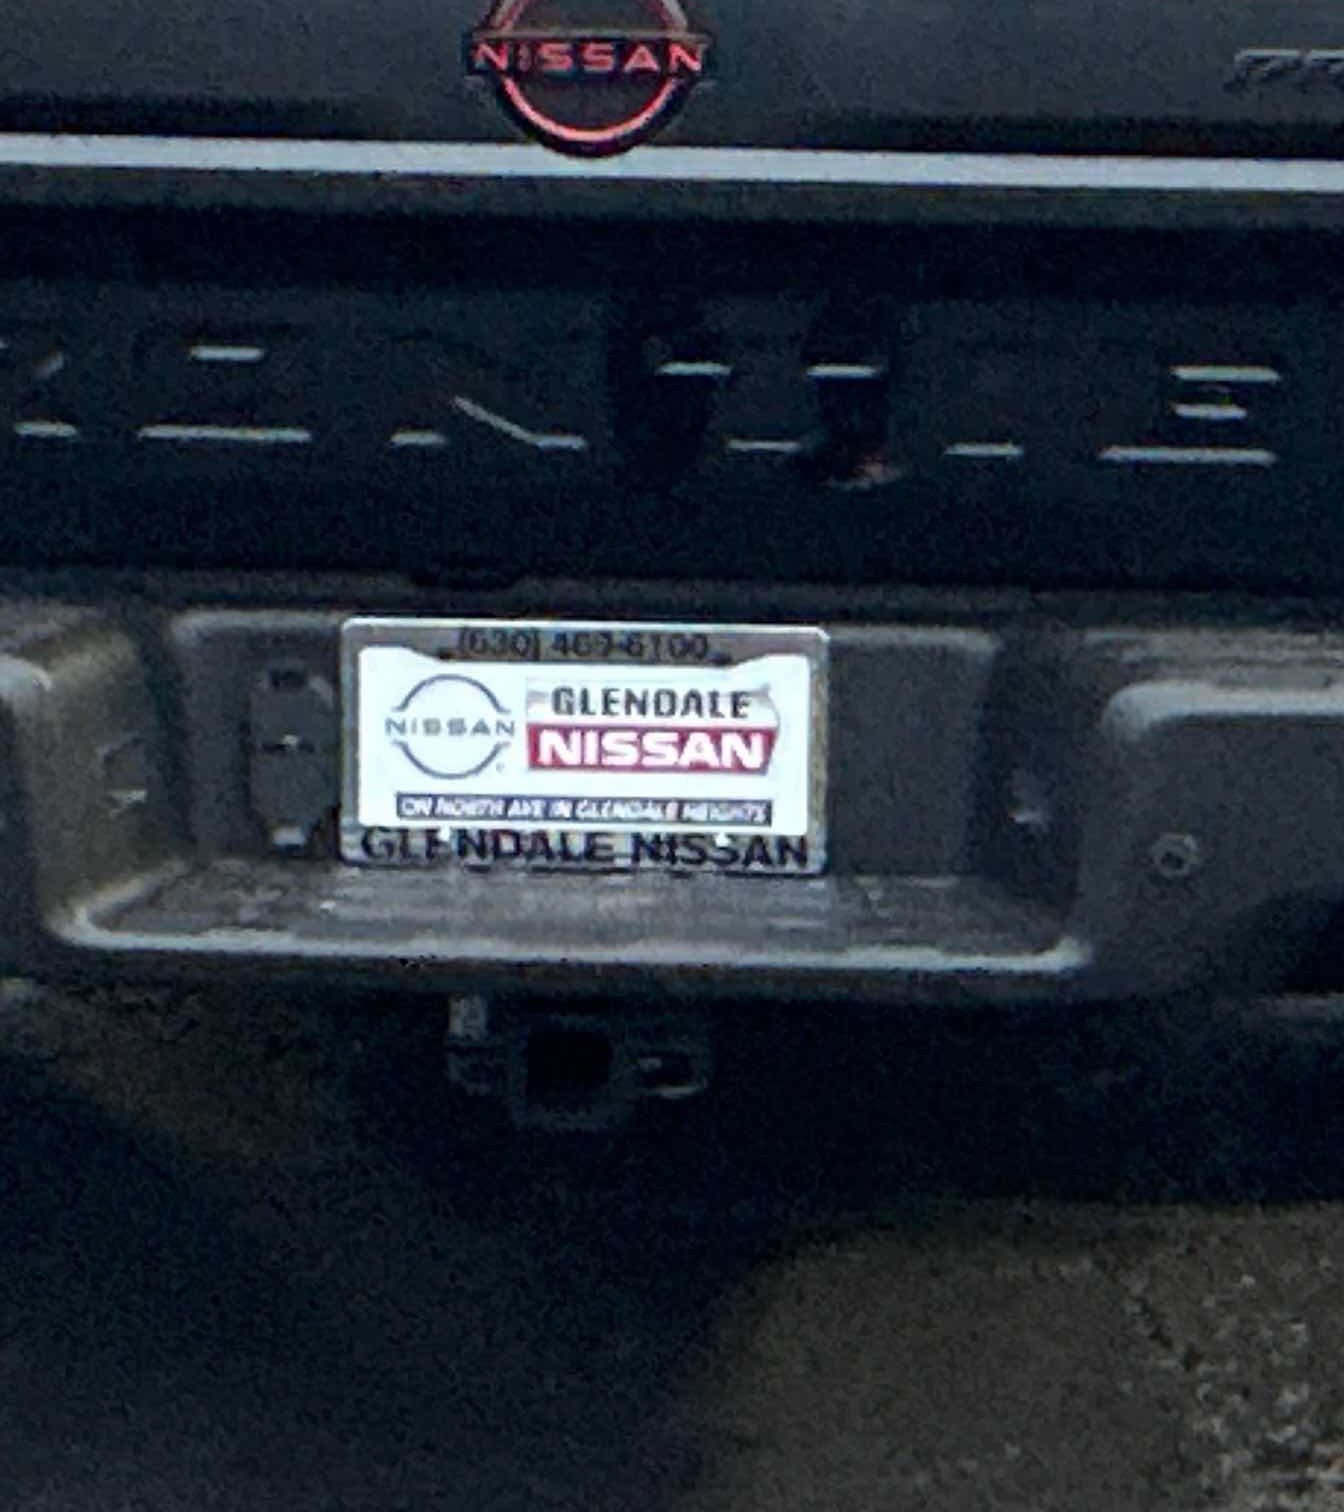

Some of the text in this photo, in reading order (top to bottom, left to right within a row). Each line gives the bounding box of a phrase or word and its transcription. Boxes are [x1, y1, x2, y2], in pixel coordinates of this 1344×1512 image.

[471, 39, 706, 73] NISSAN
[551, 687, 752, 719] GLENDALE
[384, 716, 516, 738] NISSAN
[536, 729, 765, 770] NISSAN
[400, 796, 430, 816] ON
[434, 796, 503, 818] NORTH
[574, 799, 679, 822] GLENDALE
[680, 802, 767, 824] HEIGHTS
[361, 826, 808, 867] GLENDALE NISSAN
